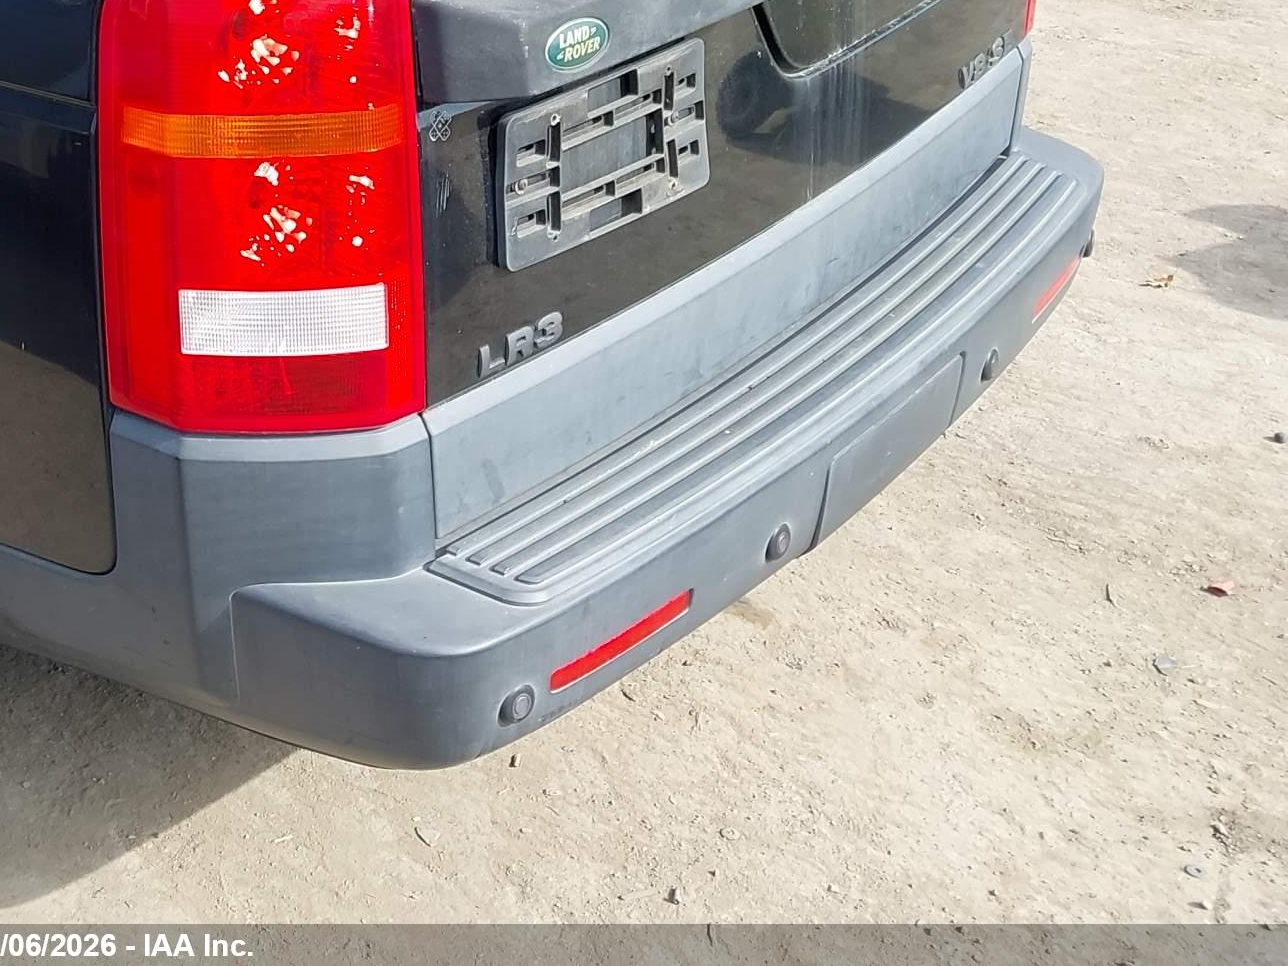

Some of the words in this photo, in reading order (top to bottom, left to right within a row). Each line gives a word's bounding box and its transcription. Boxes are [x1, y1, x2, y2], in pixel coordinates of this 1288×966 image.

[559, 25, 589, 49] LAND
[564, 36, 600, 63] ROVER
[477, 312, 563, 378] LR3
